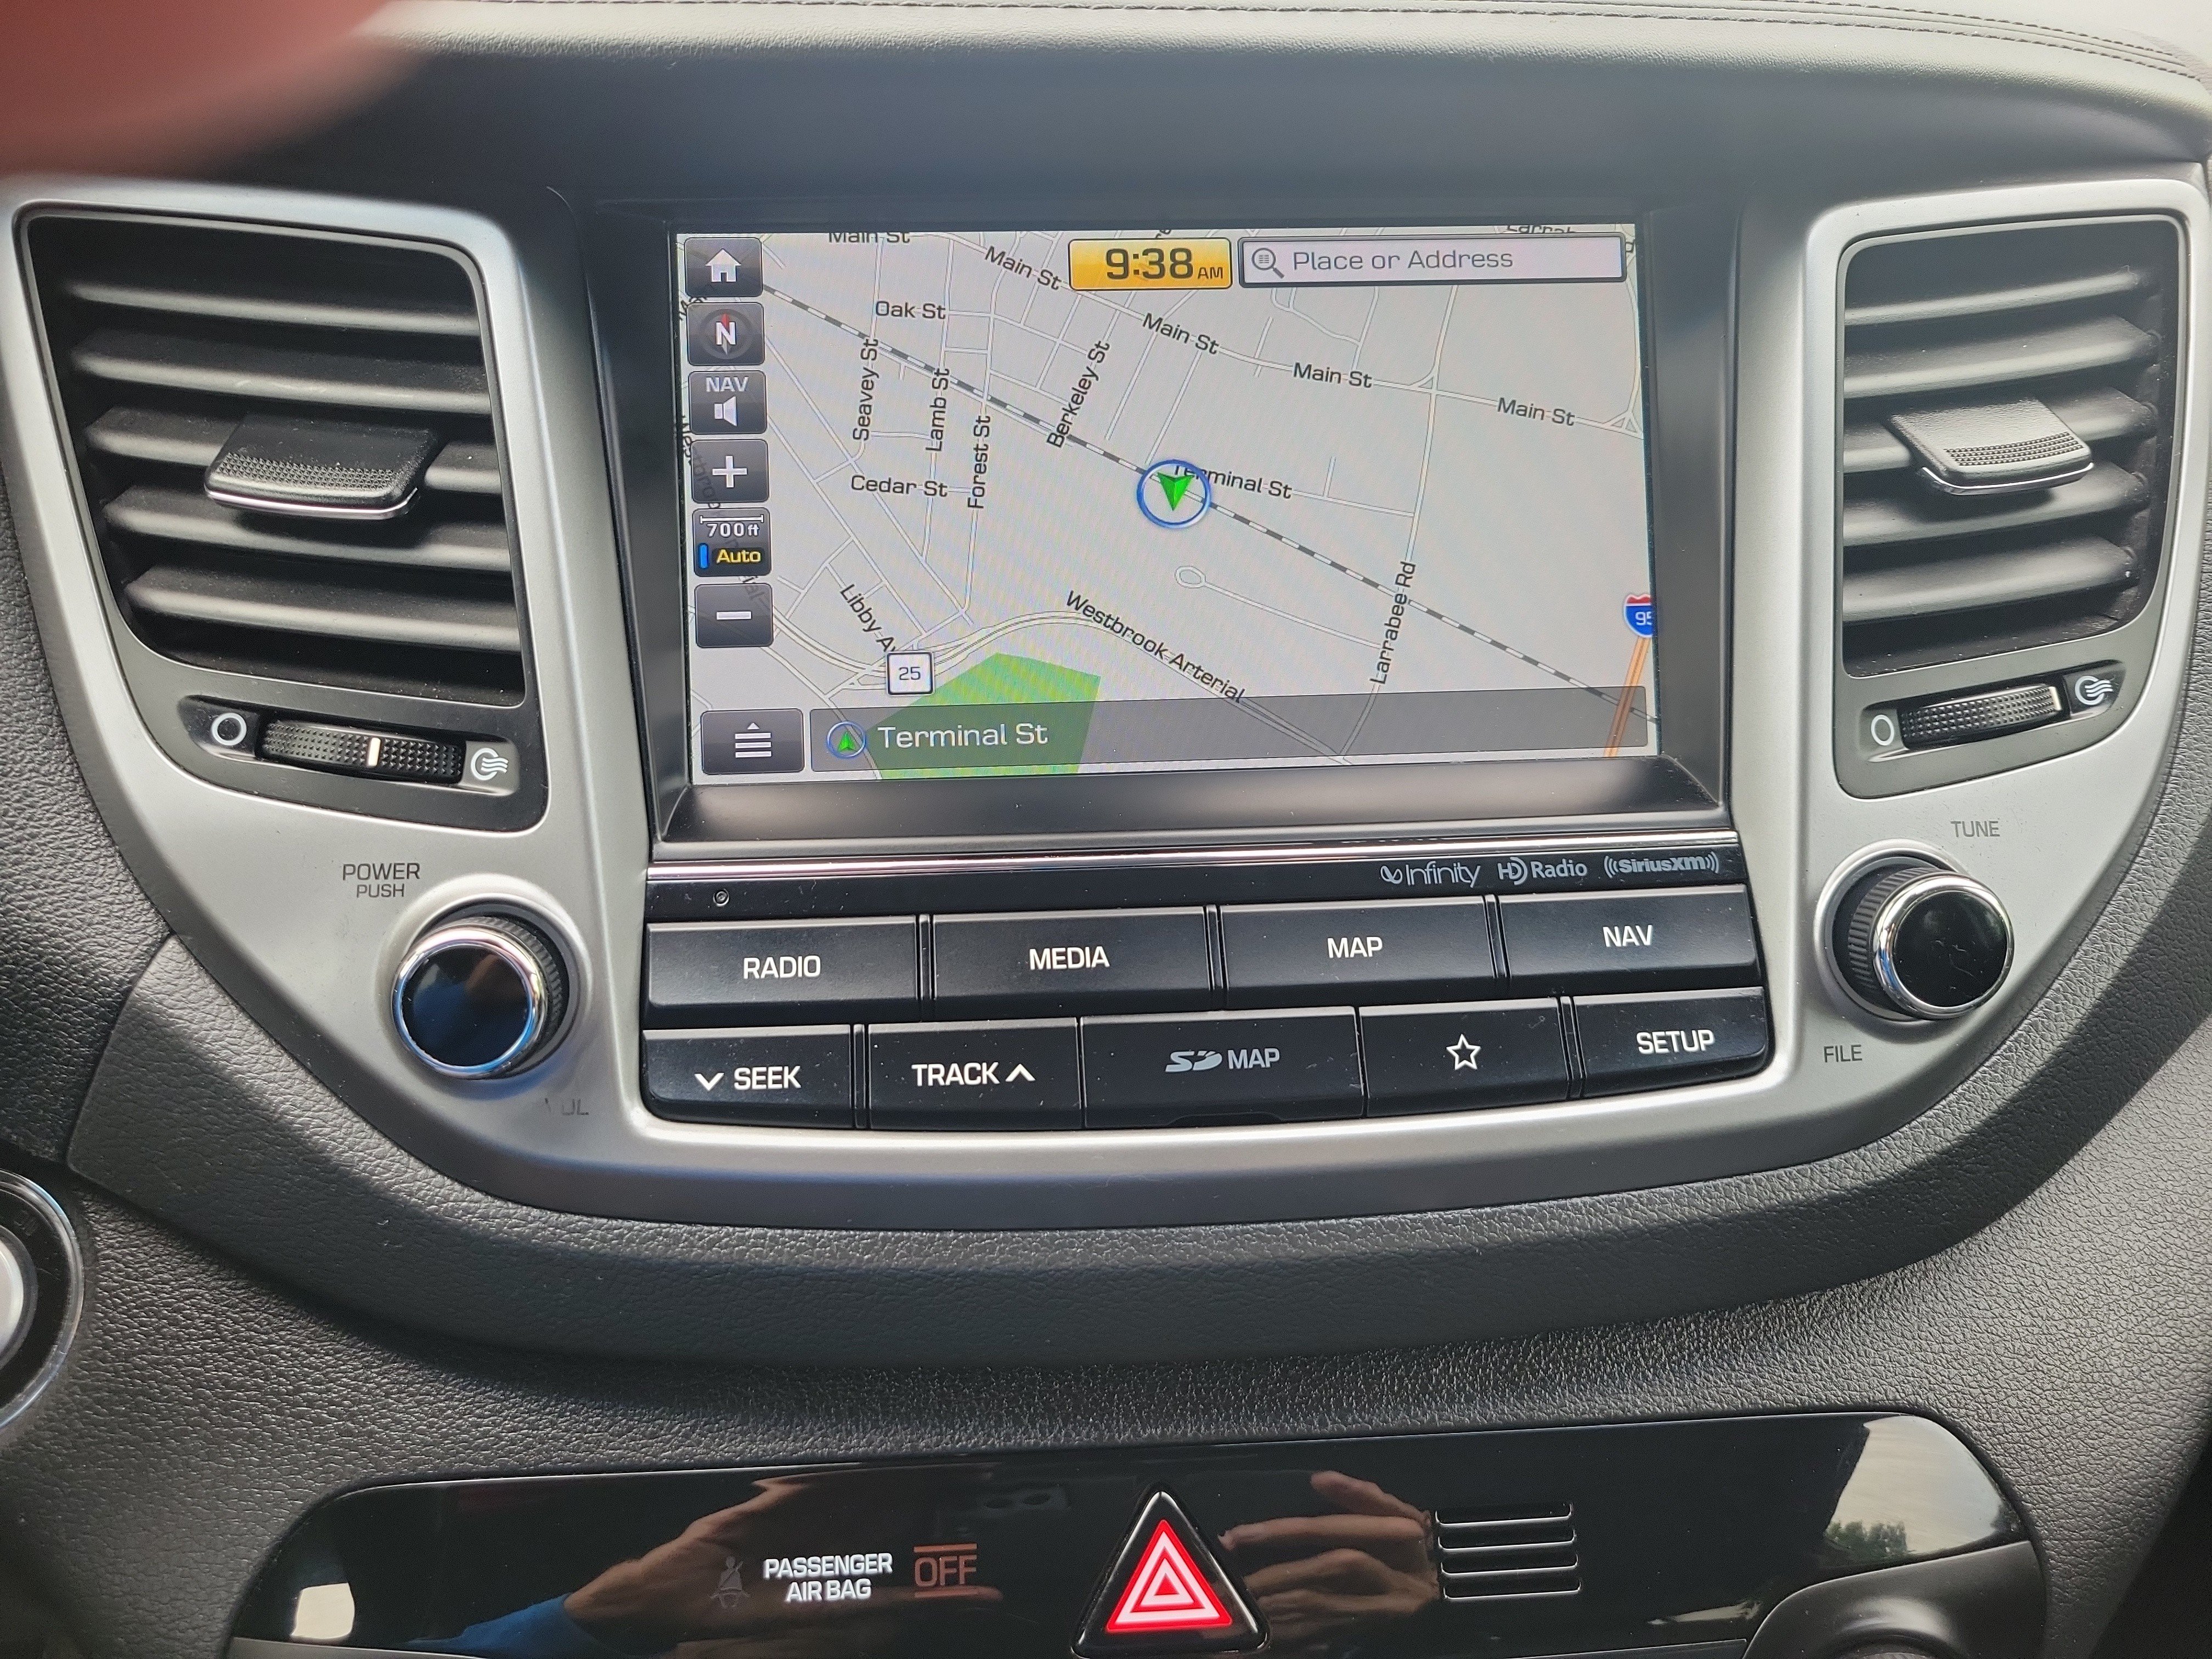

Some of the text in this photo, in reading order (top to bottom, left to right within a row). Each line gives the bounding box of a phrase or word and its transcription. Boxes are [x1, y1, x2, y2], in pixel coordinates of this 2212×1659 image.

[828, 232, 911, 244] Main St
[985, 246, 1062, 290] Main St
[1105, 247, 1224, 280] 9:38 AM
[1293, 249, 1514, 270] Place or Address
[874, 300, 946, 320] Oak St
[1142, 312, 1219, 355] Main St
[706, 376, 749, 392] NAV
[1293, 362, 1372, 389] Main St
[853, 338, 880, 441] Seavey St
[1047, 340, 1110, 448] Berkeley St
[926, 368, 950, 452] Lamb St
[1497, 397, 1576, 427] Main St
[967, 415, 991, 509] Forest St
[851, 475, 948, 498] Cedar St
[1268, 481, 1293, 499] St
[716, 549, 762, 564] Auto
[840, 584, 882, 634] Libby
[1369, 561, 1417, 685] Larrabee Rd
[1066, 590, 1246, 704] Westbrook Arterial
[898, 667, 922, 680] 25
[877, 724, 1048, 748] Terminal St
[1950, 820, 2001, 838] TUNE
[342, 862, 421, 881] POWER
[1405, 860, 1481, 888] Infinity
[1530, 858, 1588, 879] Radio
[356, 883, 405, 899] PUSH
[1327, 936, 1383, 959] MAP
[1602, 924, 1654, 947] NAV
[742, 955, 822, 979] RADIO
[1029, 946, 1110, 971] MEDIA
[1635, 1029, 1715, 1056] SETUP
[1823, 1044, 1863, 1063] FILE
[1227, 1047, 1280, 1070] MAP
[733, 1065, 802, 1091] SEEK
[911, 1061, 1000, 1087] TRACK
[763, 1553, 893, 1579] PASSENGER
[914, 1554, 978, 1588] OFF
[786, 1578, 872, 1602] AIR BAG
